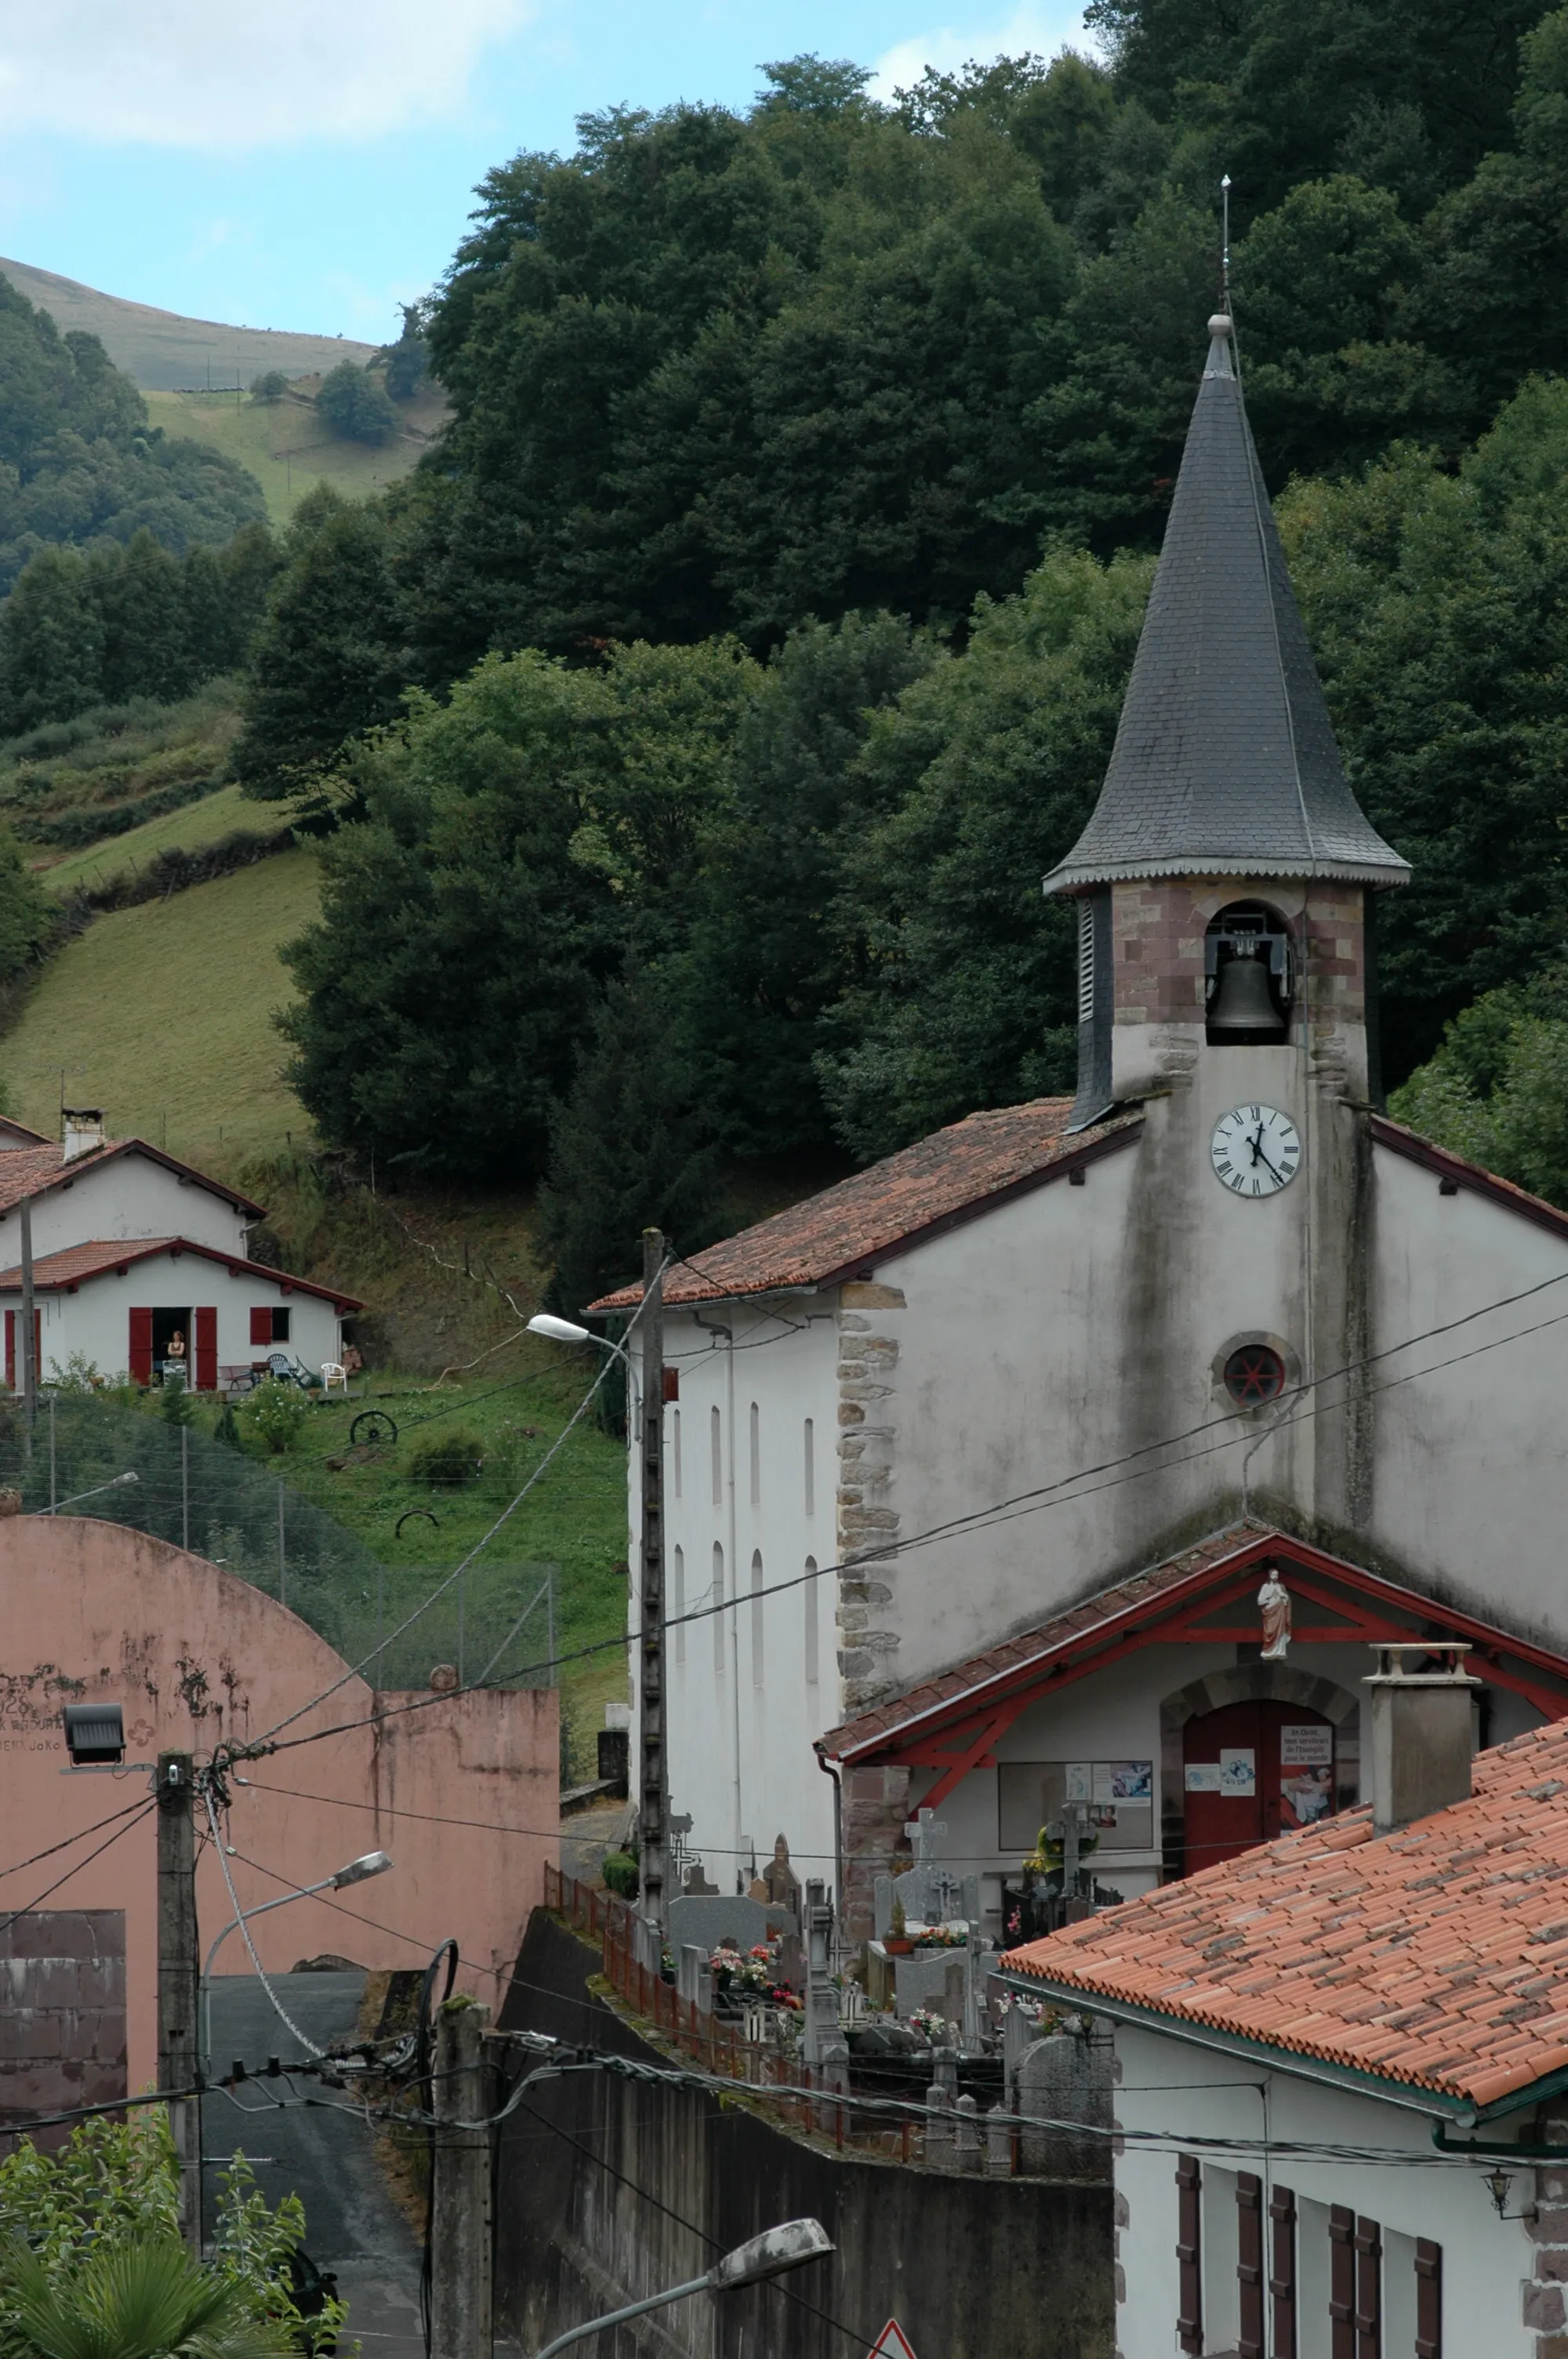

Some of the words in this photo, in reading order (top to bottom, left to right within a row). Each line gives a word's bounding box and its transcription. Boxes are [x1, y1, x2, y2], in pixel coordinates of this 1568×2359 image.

[1231, 1111, 1244, 1125] XI
[1250, 1107, 1261, 1121] XII
[1269, 1112, 1277, 1125] I
[1218, 1126, 1232, 1138] X
[1279, 1126, 1293, 1137] II
[1217, 1160, 1234, 1177] VIII
[1231, 1173, 1245, 1190] VII
[1253, 1179, 1261, 1194] VI
